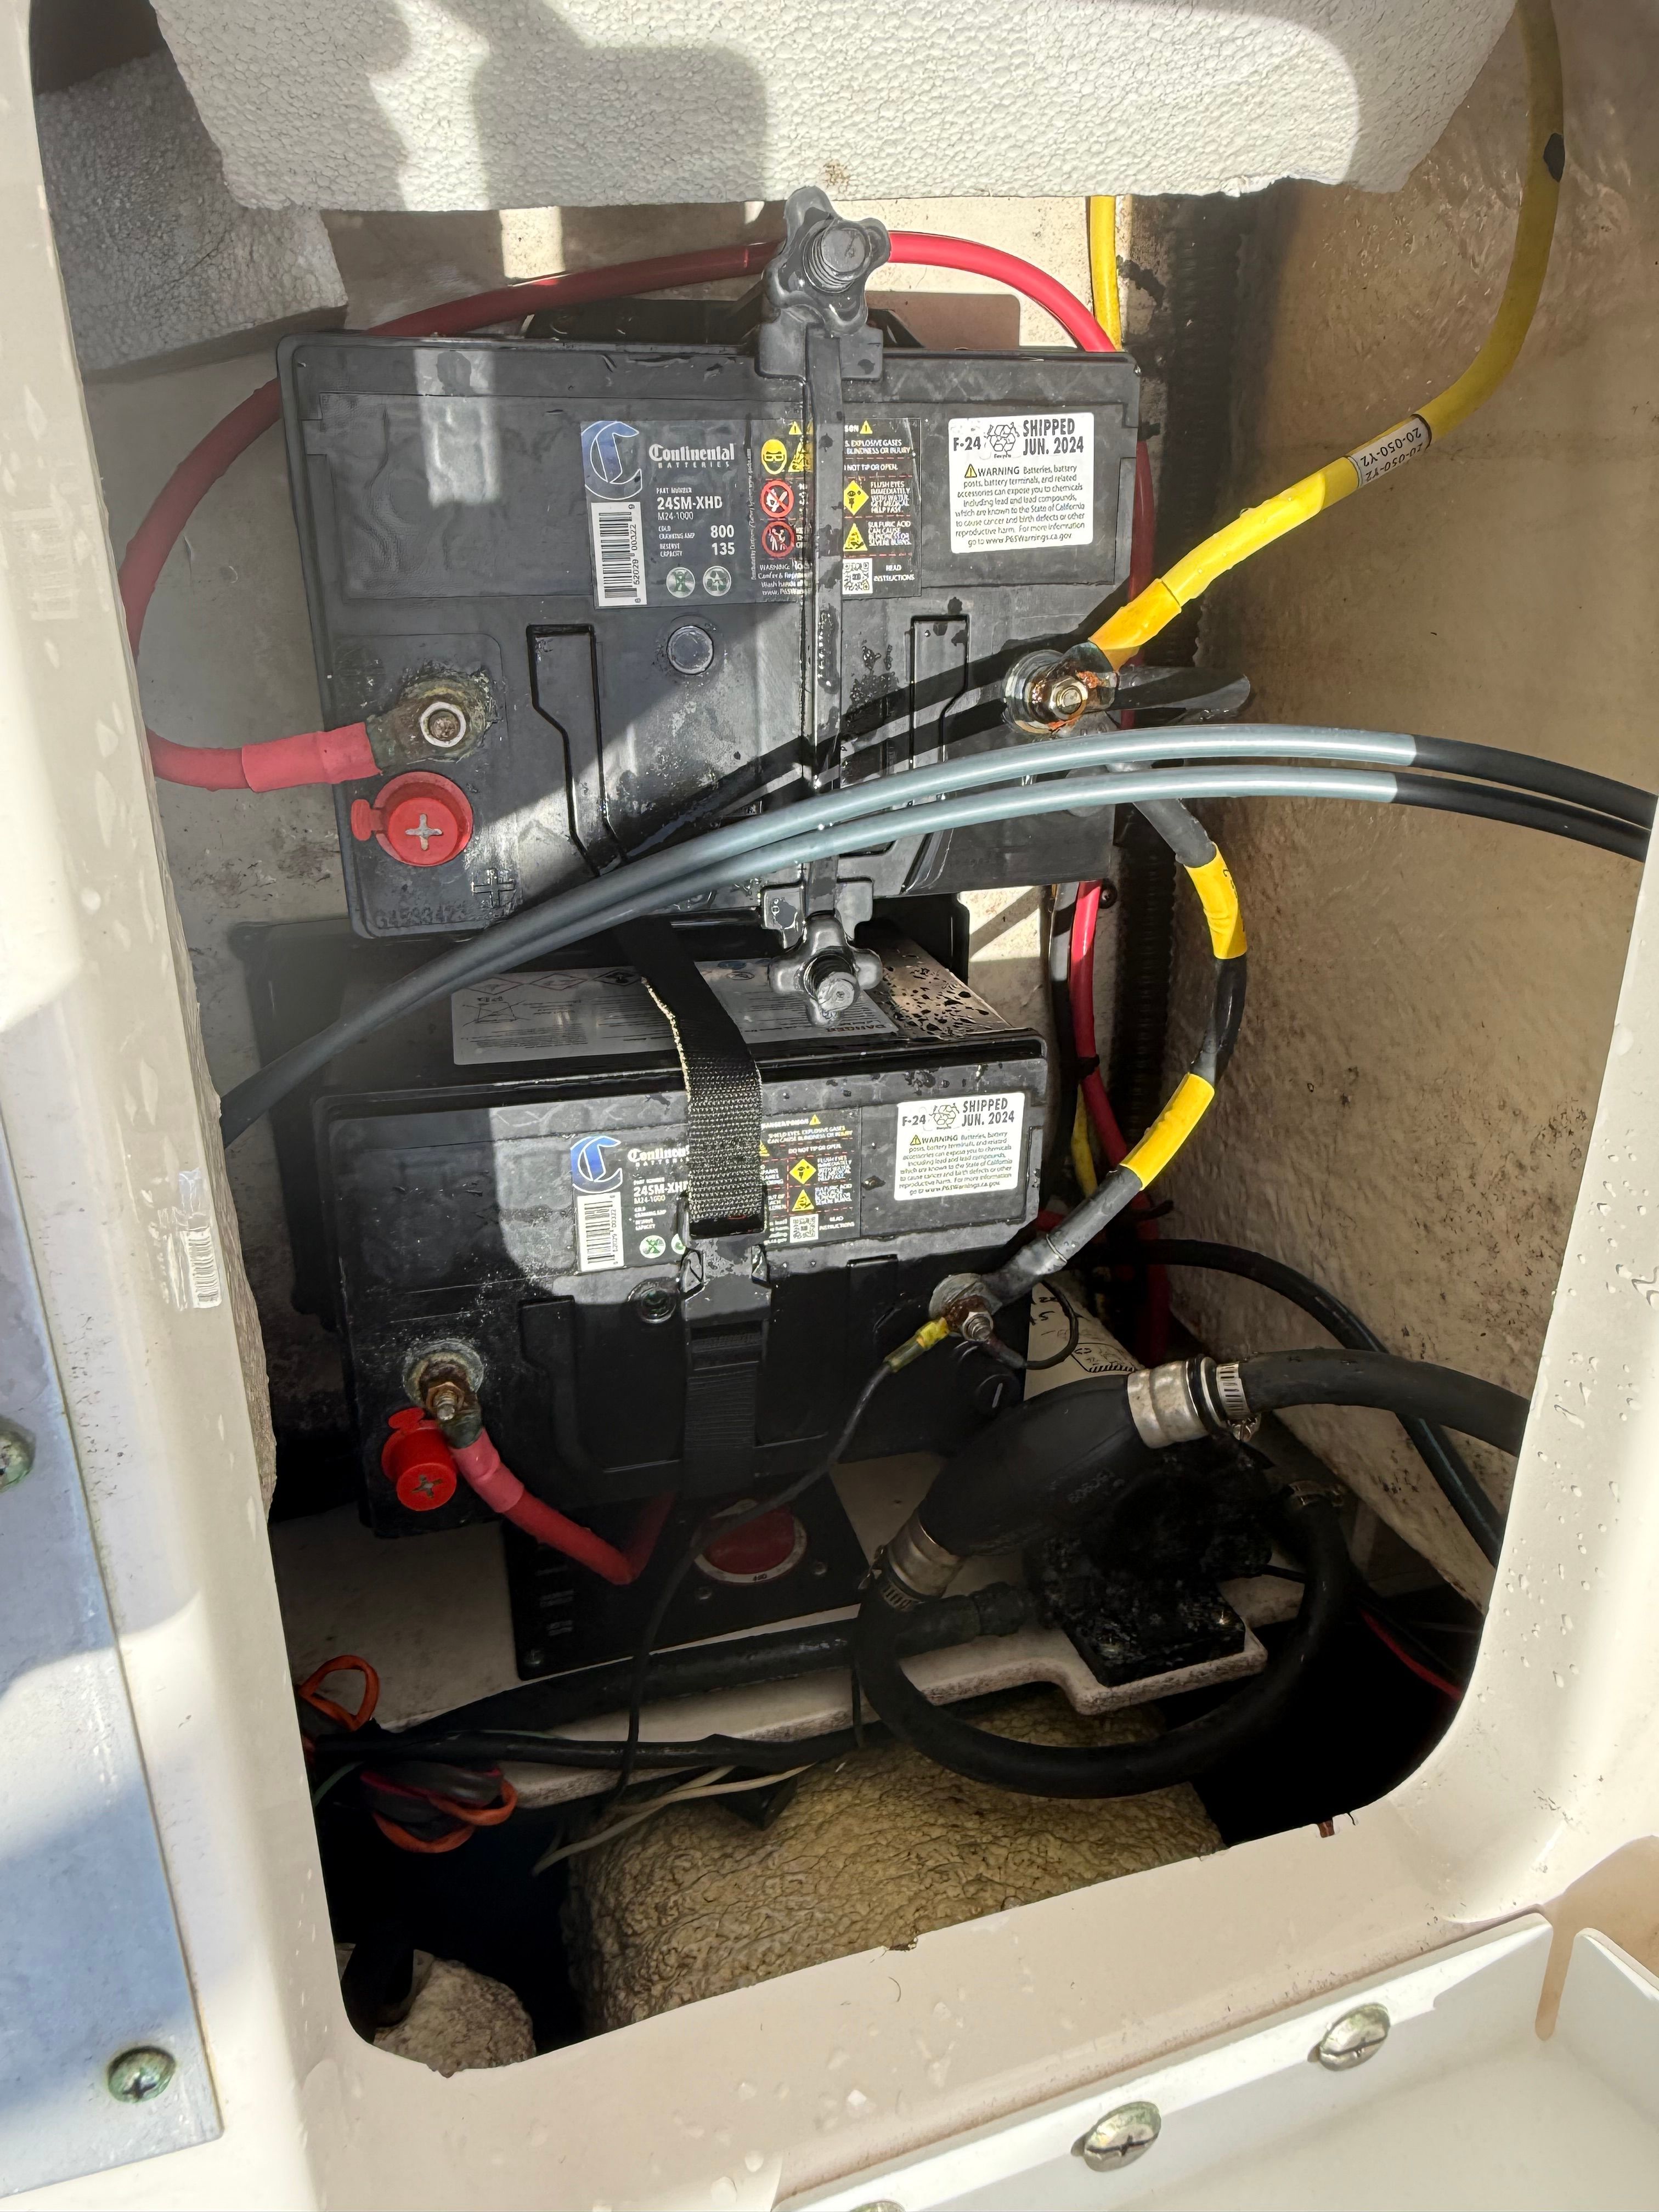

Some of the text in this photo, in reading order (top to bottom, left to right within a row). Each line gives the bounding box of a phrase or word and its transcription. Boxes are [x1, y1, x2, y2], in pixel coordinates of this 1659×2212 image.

[1023, 418, 1075, 437] SHIPPED
[953, 436, 981, 451] F-24
[1023, 436, 1084, 456] JUN. 2024
[649, 443, 735, 461] Continental
[978, 466, 1019, 477] WARNING
[1054, 464, 1077, 472] battery
[984, 478, 1007, 487] battery
[1055, 474, 1077, 482] related
[1031, 487, 1042, 495] you
[657, 495, 723, 510] 24SM-XHD
[710, 524, 735, 538] 800
[712, 542, 735, 556] 135
[963, 1097, 1008, 1113] SHIPPED
[902, 1114, 926, 1126] F-24
[962, 1110, 1015, 1127] JUN. 2024
[922, 1135, 958, 1144] WARNING
